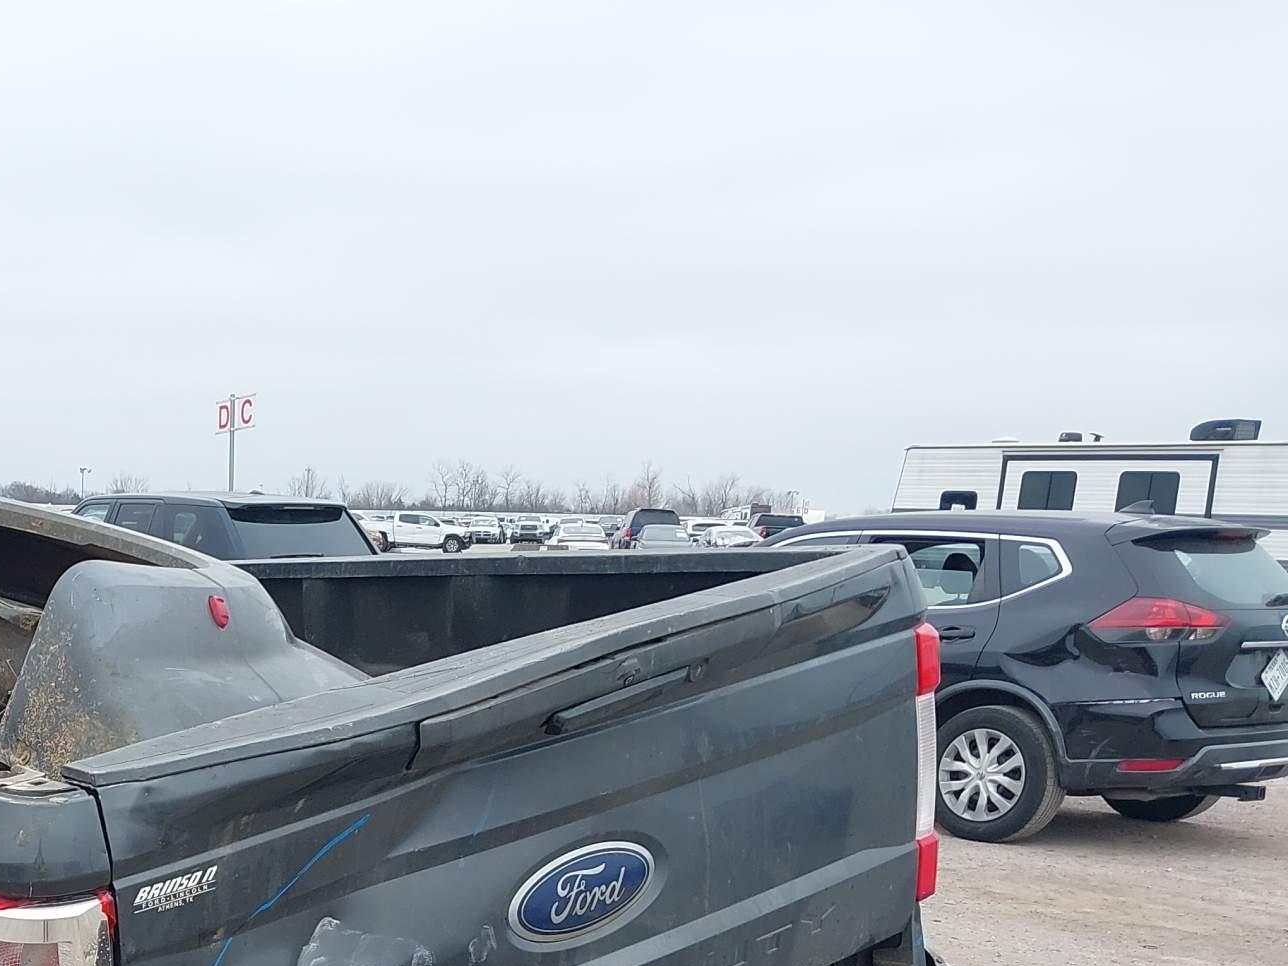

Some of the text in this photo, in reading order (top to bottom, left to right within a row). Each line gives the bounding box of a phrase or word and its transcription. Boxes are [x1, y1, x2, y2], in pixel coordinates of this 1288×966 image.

[219, 399, 252, 429] D C
[1191, 691, 1226, 700] ROGUE
[550, 862, 626, 925] Ford
